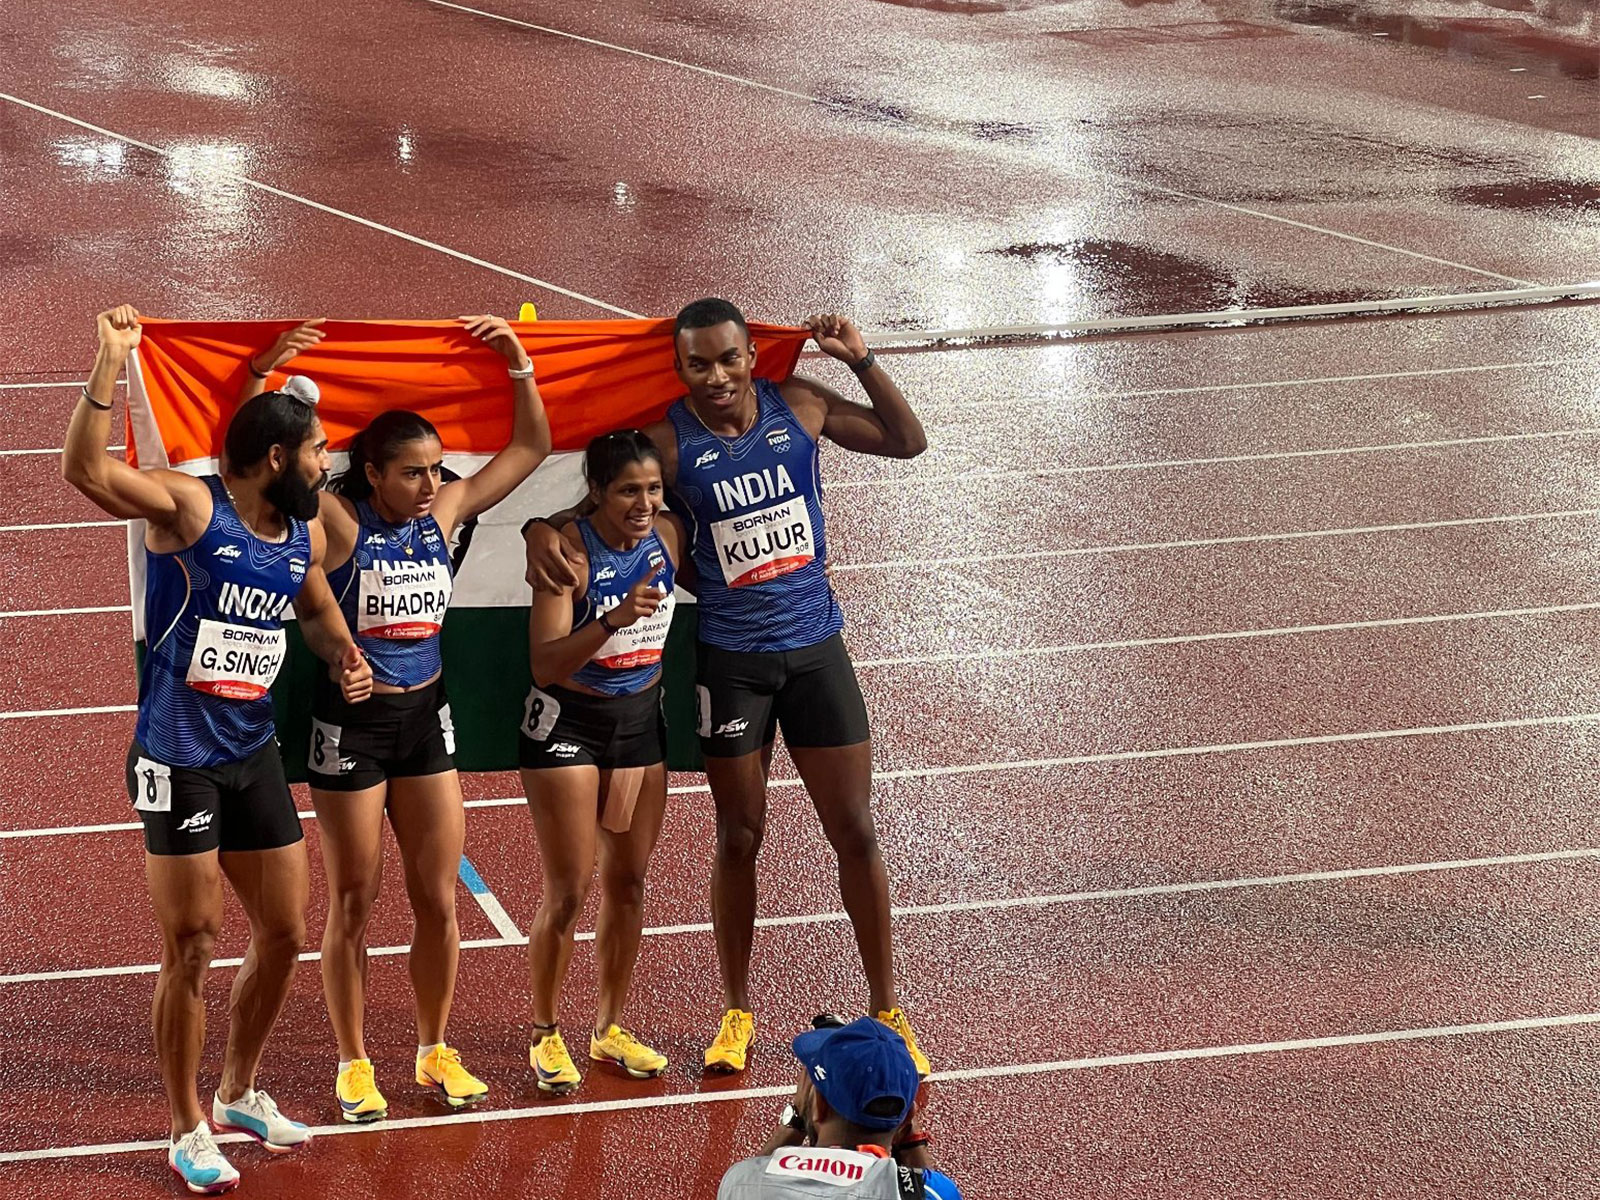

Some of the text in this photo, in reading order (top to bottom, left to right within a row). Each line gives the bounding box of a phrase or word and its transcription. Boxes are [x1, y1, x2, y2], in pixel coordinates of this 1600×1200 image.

[767, 434, 791, 446] INDIA
[694, 450, 720, 468] JSW
[713, 464, 796, 513] INDIA
[732, 507, 791, 532] BORNAN
[213, 546, 242, 558] JSW
[723, 521, 807, 565] KUJUR
[795, 541, 809, 555] 308
[383, 571, 435, 586] BORNAN
[594, 568, 617, 583] JSW
[217, 581, 288, 621] INDIA
[366, 589, 446, 617] BHADRA
[222, 628, 280, 646] BORNAN
[200, 646, 281, 677] G.SINGH
[527, 697, 545, 732] 8
[714, 718, 750, 734] JSW
[313, 727, 326, 767] 8
[545, 742, 582, 754] JSW
[176, 810, 214, 831] JSW
[778, 1154, 864, 1180] Canon
[899, 1165, 915, 1193] ONY
